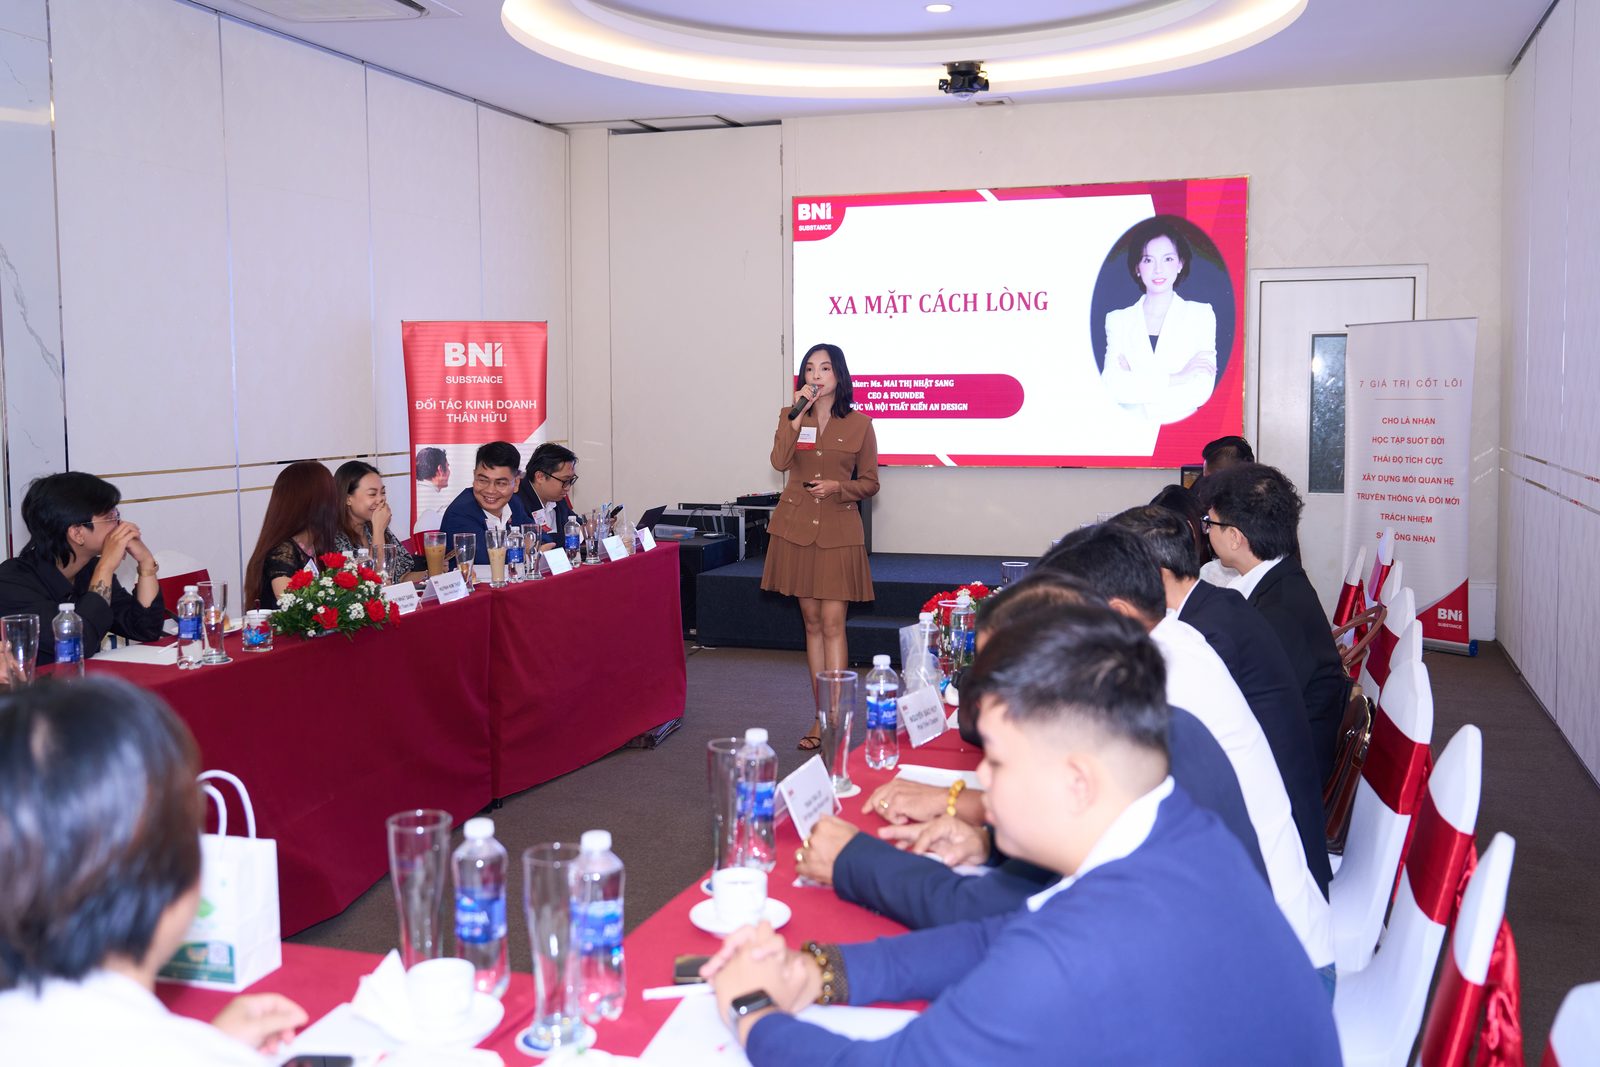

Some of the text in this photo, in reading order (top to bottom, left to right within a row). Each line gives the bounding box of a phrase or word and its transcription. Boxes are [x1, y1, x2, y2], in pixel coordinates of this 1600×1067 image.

[829, 286, 1049, 319] XA MẶT CÁCH LÒNG
[445, 375, 503, 384] SUBSTANCE
[870, 380, 883, 388] Ms.
[883, 379, 898, 388] MAI
[899, 379, 912, 389] THỊ
[935, 379, 954, 388] SANG
[1359, 380, 1365, 388] 7
[867, 391, 925, 400] CEO & FOUNDER
[415, 398, 537, 410] ĐỐI TÁC KINH DOANH
[864, 401, 875, 411] VÀ
[929, 403, 940, 411] AN
[940, 402, 968, 411] DESIGN
[446, 412, 507, 423] THÂN HỮU
[1382, 417, 1399, 425] CHO
[1418, 476, 1442, 485] QUAN
[1394, 531, 1411, 541] ÔNG
